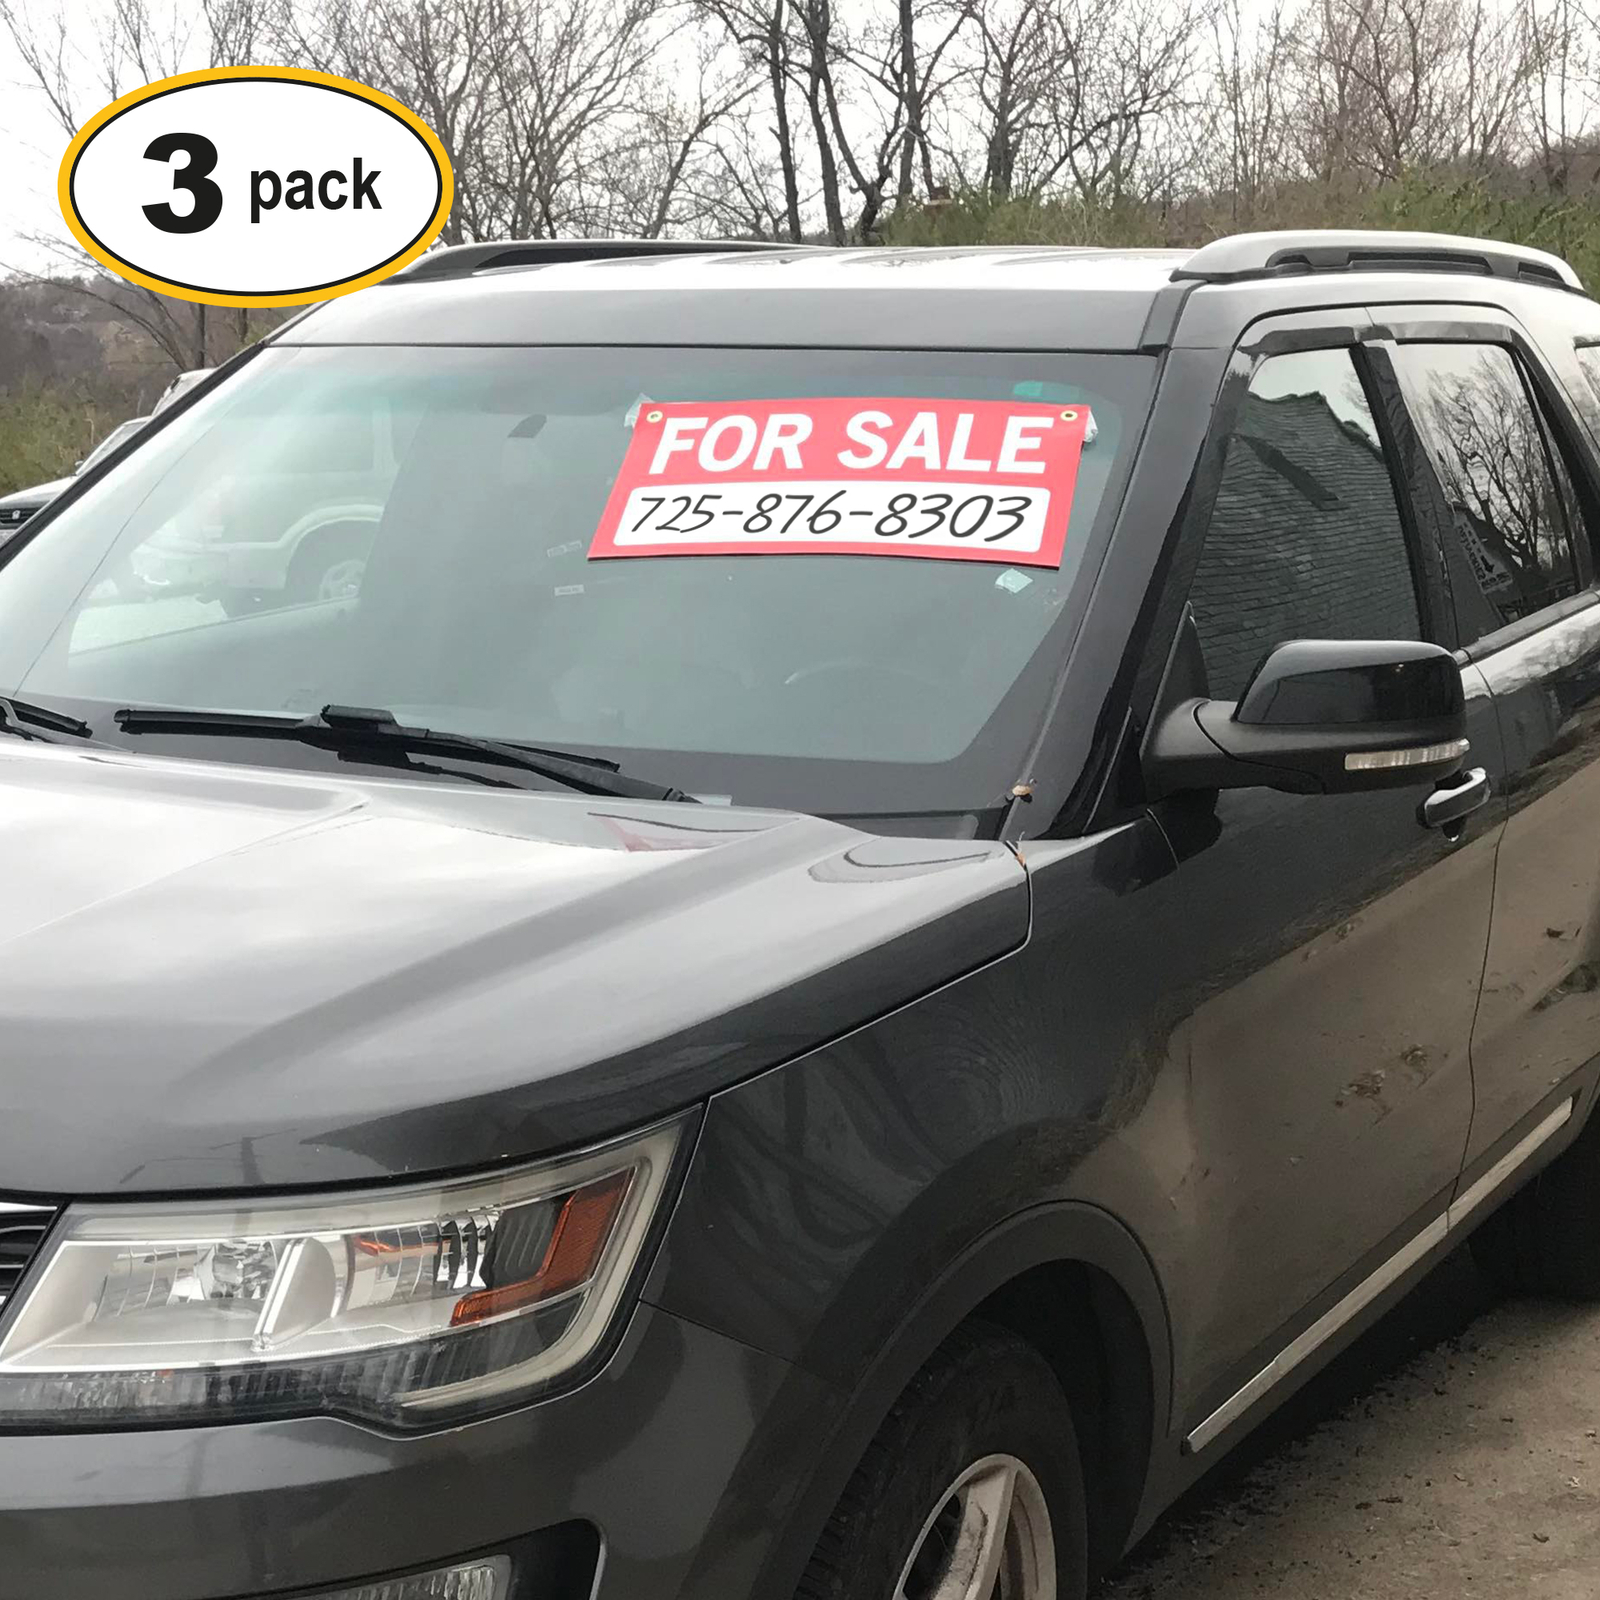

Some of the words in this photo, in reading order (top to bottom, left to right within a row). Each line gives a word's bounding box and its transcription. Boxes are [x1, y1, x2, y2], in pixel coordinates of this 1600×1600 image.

[648, 413, 813, 474] FOR
[838, 411, 1054, 473] SALE
[632, 490, 1032, 541] 725-876-8303
